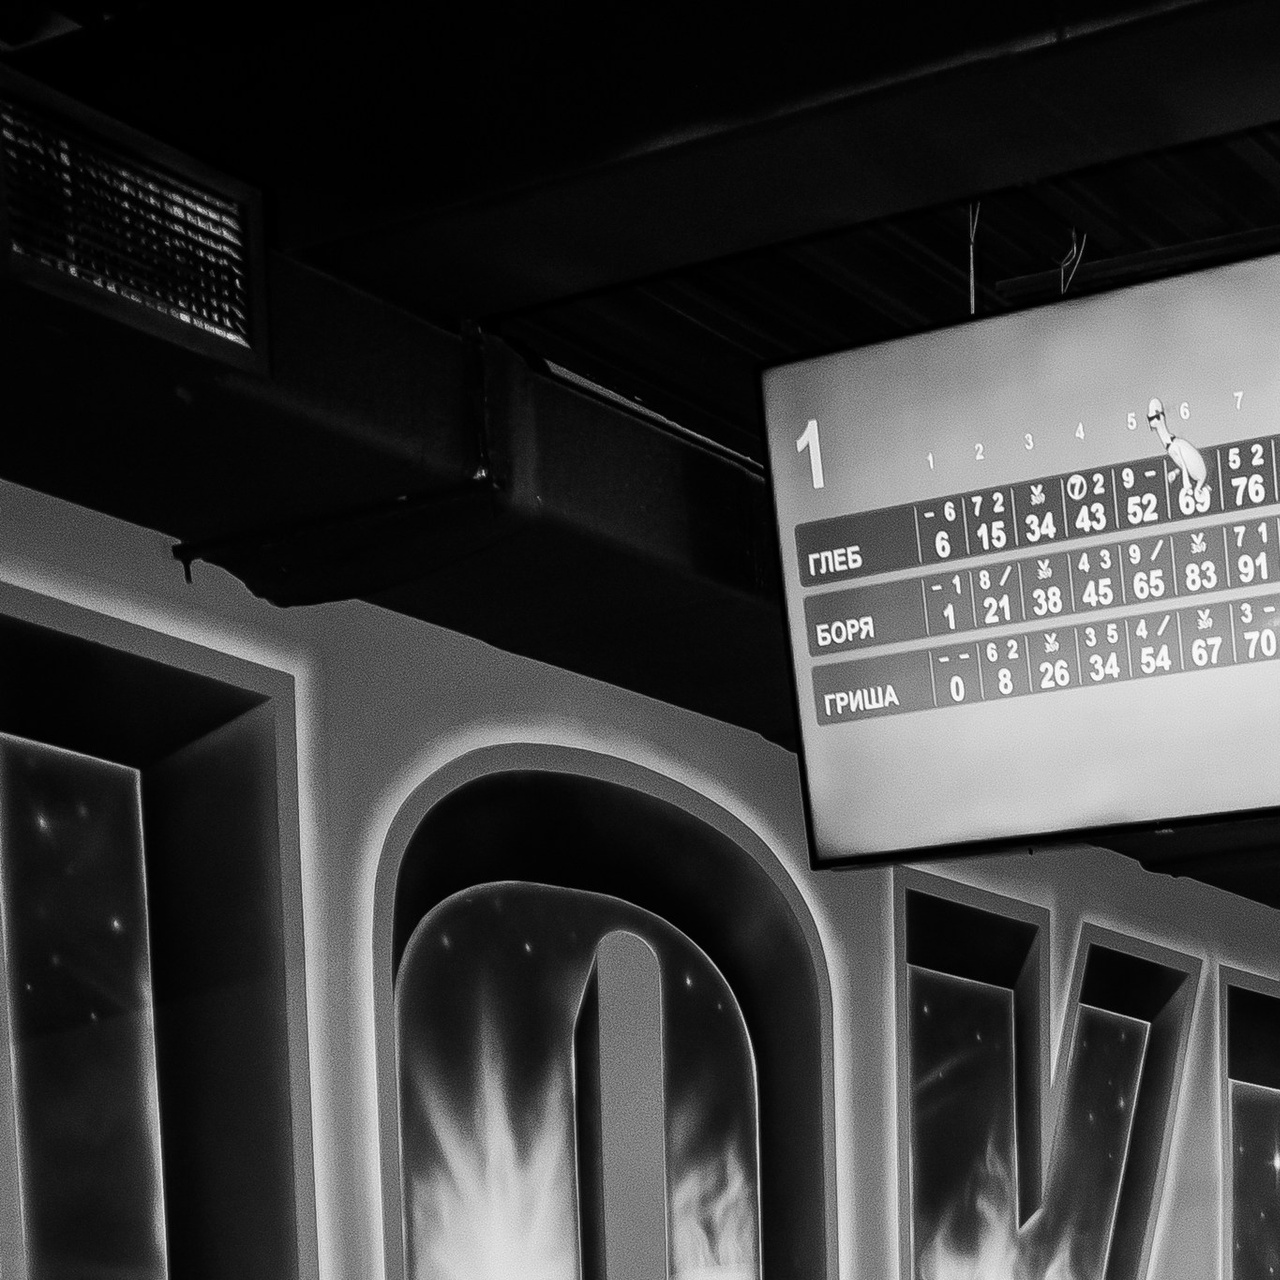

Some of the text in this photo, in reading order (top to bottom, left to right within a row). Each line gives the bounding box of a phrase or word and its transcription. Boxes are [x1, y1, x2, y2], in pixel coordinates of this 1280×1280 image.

[796, 419, 825, 490] 1
[927, 453, 933, 468] 1
[975, 443, 984, 460] 2
[1025, 434, 1033, 450] 3
[1076, 423, 1084, 439] 4
[1128, 413, 1136, 429] 5
[1180, 402, 1189, 419] 6
[1234, 391, 1243, 409] 7
[944, 502, 956, 521] 6
[972, 496, 982, 516] 7
[993, 493, 1004, 513] 2
[1093, 474, 1105, 494] 2
[1122, 468, 1134, 489] 9
[1229, 448, 1240, 469] 5
[1251, 444, 1264, 466] 2
[809, 545, 862, 575] ГЛЕБ
[935, 531, 950, 557] 6
[977, 521, 1006, 549] 15
[1025, 512, 1056, 541] 34
[1076, 503, 1106, 531] 43
[1128, 493, 1158, 523] 52
[1179, 487, 1210, 515] 69
[1231, 474, 1265, 505] 76
[952, 575, 961, 594] 1
[980, 570, 990, 589] 8
[1078, 553, 1090, 572] 4
[1100, 550, 1111, 569] 3
[1129, 544, 1141, 564] 9
[1234, 526, 1245, 547] 7
[1258, 523, 1268, 543] 1
[817, 616, 874, 645] БОРЯ
[943, 603, 955, 629] 1
[984, 595, 1010, 623] 21
[1033, 586, 1062, 615] 38
[1083, 578, 1113, 606] 45
[1134, 569, 1164, 598] 65
[1186, 561, 1217, 590] 83
[1238, 552, 1267, 582] 91
[987, 643, 998, 662] 6
[1008, 640, 1018, 659] 2
[1086, 628, 1096, 646] 3
[1107, 624, 1118, 643] 5
[1136, 620, 1147, 638] 4
[1241, 603, 1252, 623] 3
[825, 685, 899, 715] ГРИША
[950, 676, 964, 701] 0
[998, 668, 1012, 694] 8
[1040, 660, 1069, 688] 26
[1090, 653, 1119, 680] 34
[1141, 645, 1171, 673] 54
[1192, 637, 1222, 665] 67
[1244, 629, 1276, 657] 70
